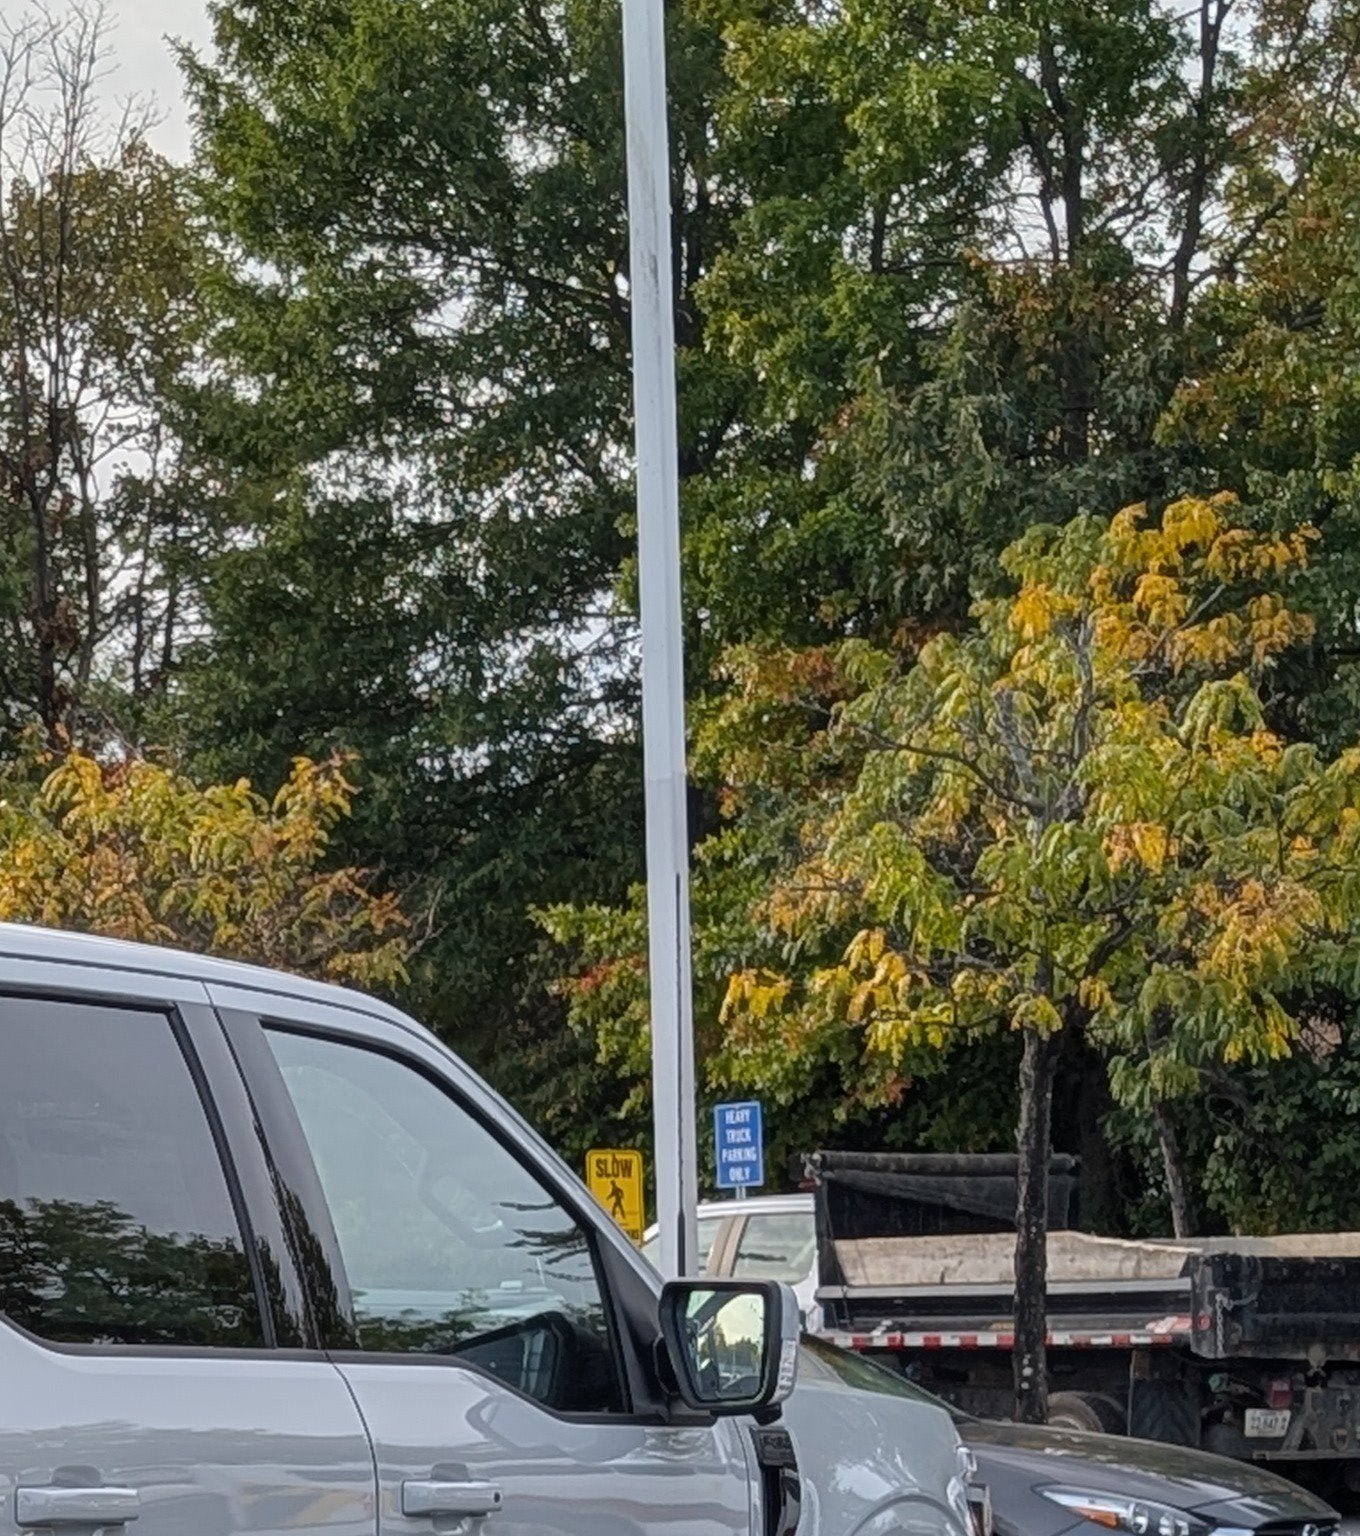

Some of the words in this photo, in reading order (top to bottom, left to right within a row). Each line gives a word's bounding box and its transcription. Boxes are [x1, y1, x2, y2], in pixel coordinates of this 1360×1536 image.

[725, 1109, 751, 1125] HEAVY
[725, 1127, 752, 1144] TRUCK
[722, 1146, 757, 1163] PARKING
[596, 1158, 633, 1178] SLOW
[728, 1166, 751, 1182] ONLY
